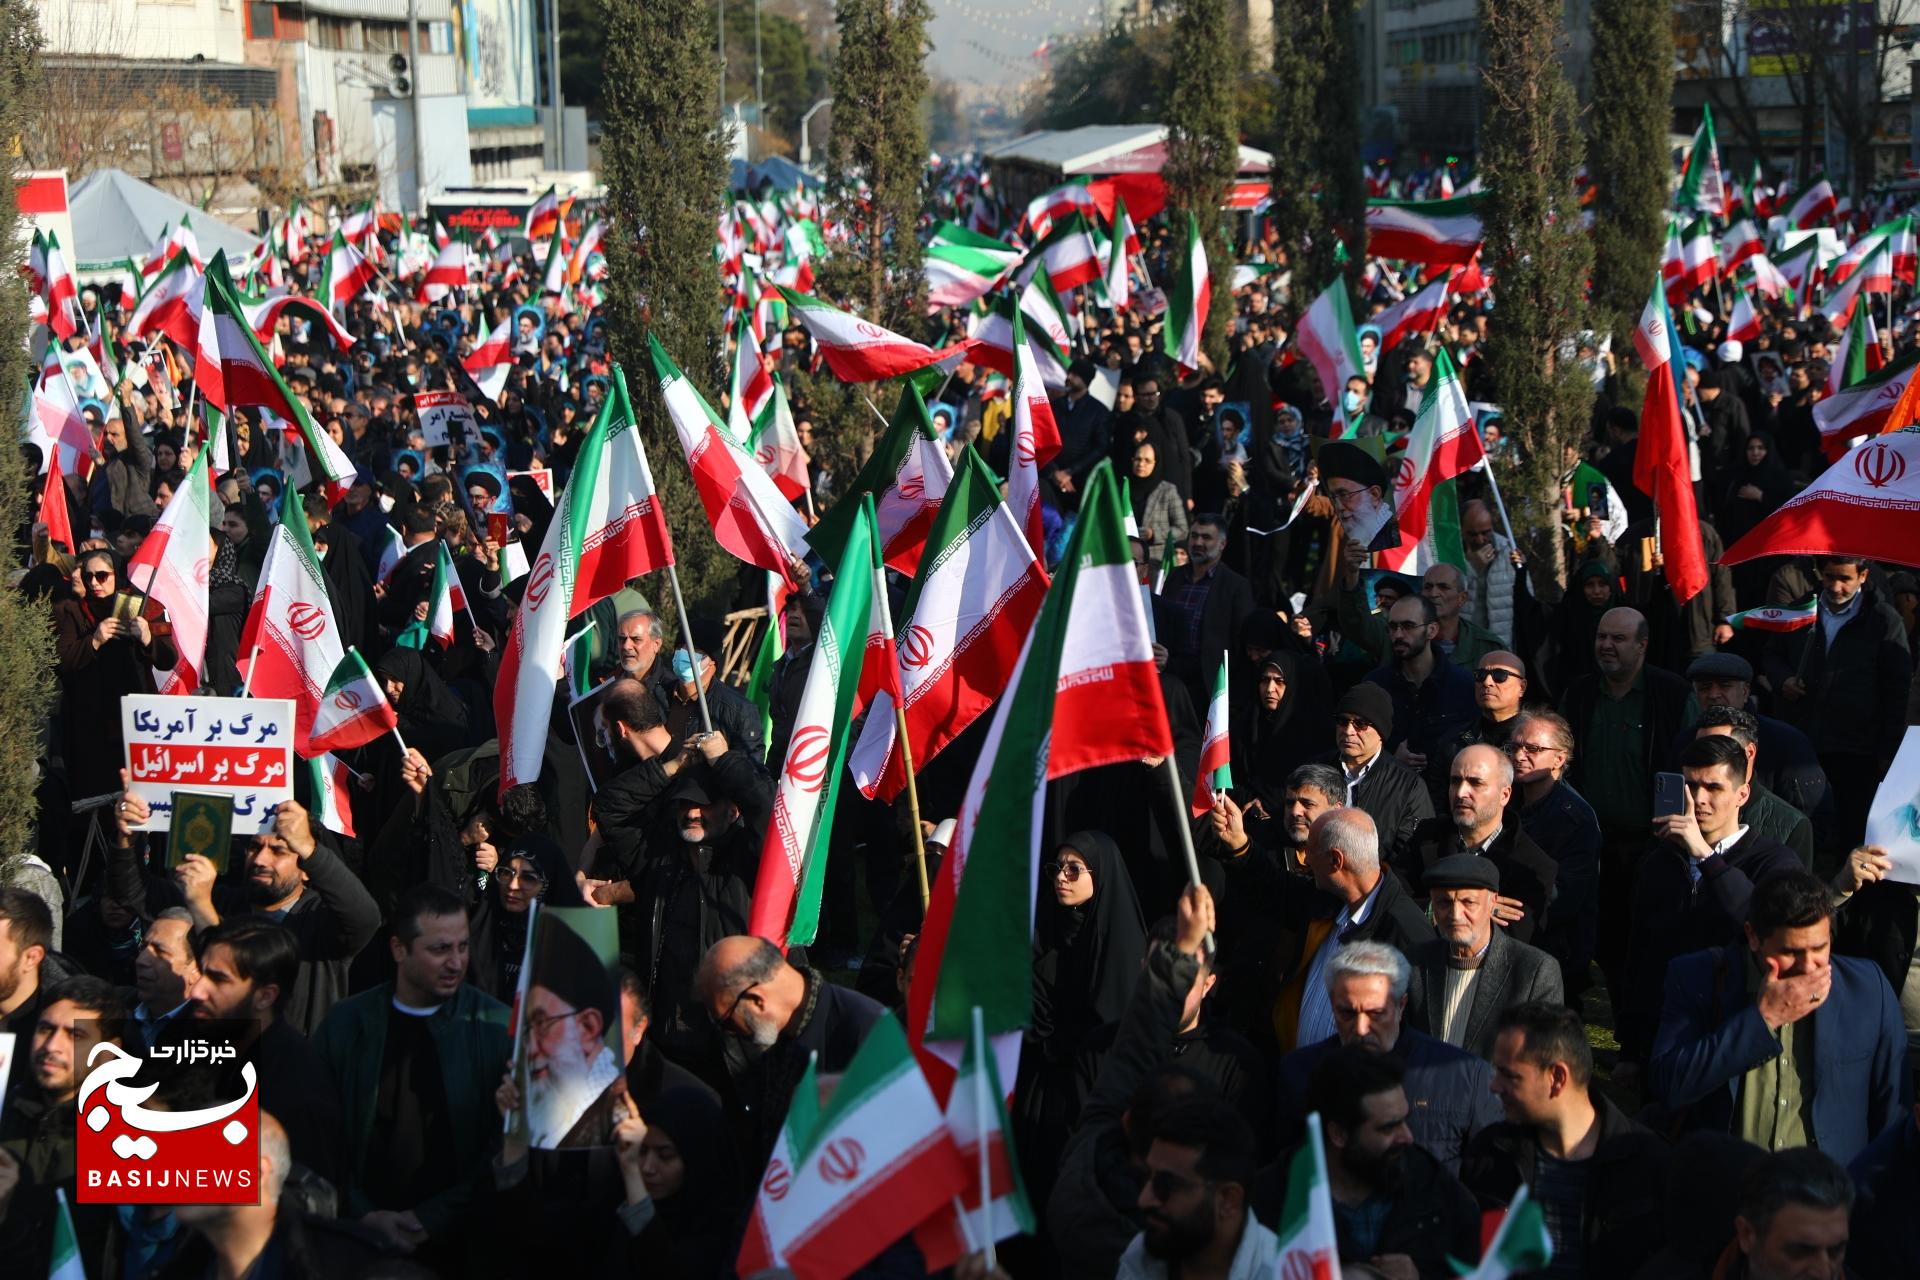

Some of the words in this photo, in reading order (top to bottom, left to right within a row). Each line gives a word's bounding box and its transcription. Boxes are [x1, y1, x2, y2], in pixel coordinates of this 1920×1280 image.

[133, 708, 198, 740] آمریکا
[204, 719, 223, 742] بر
[229, 712, 278, 743] مرگ
[133, 746, 205, 780] اسرائیل
[209, 757, 230, 782] بر
[233, 752, 285, 784] مرگ
